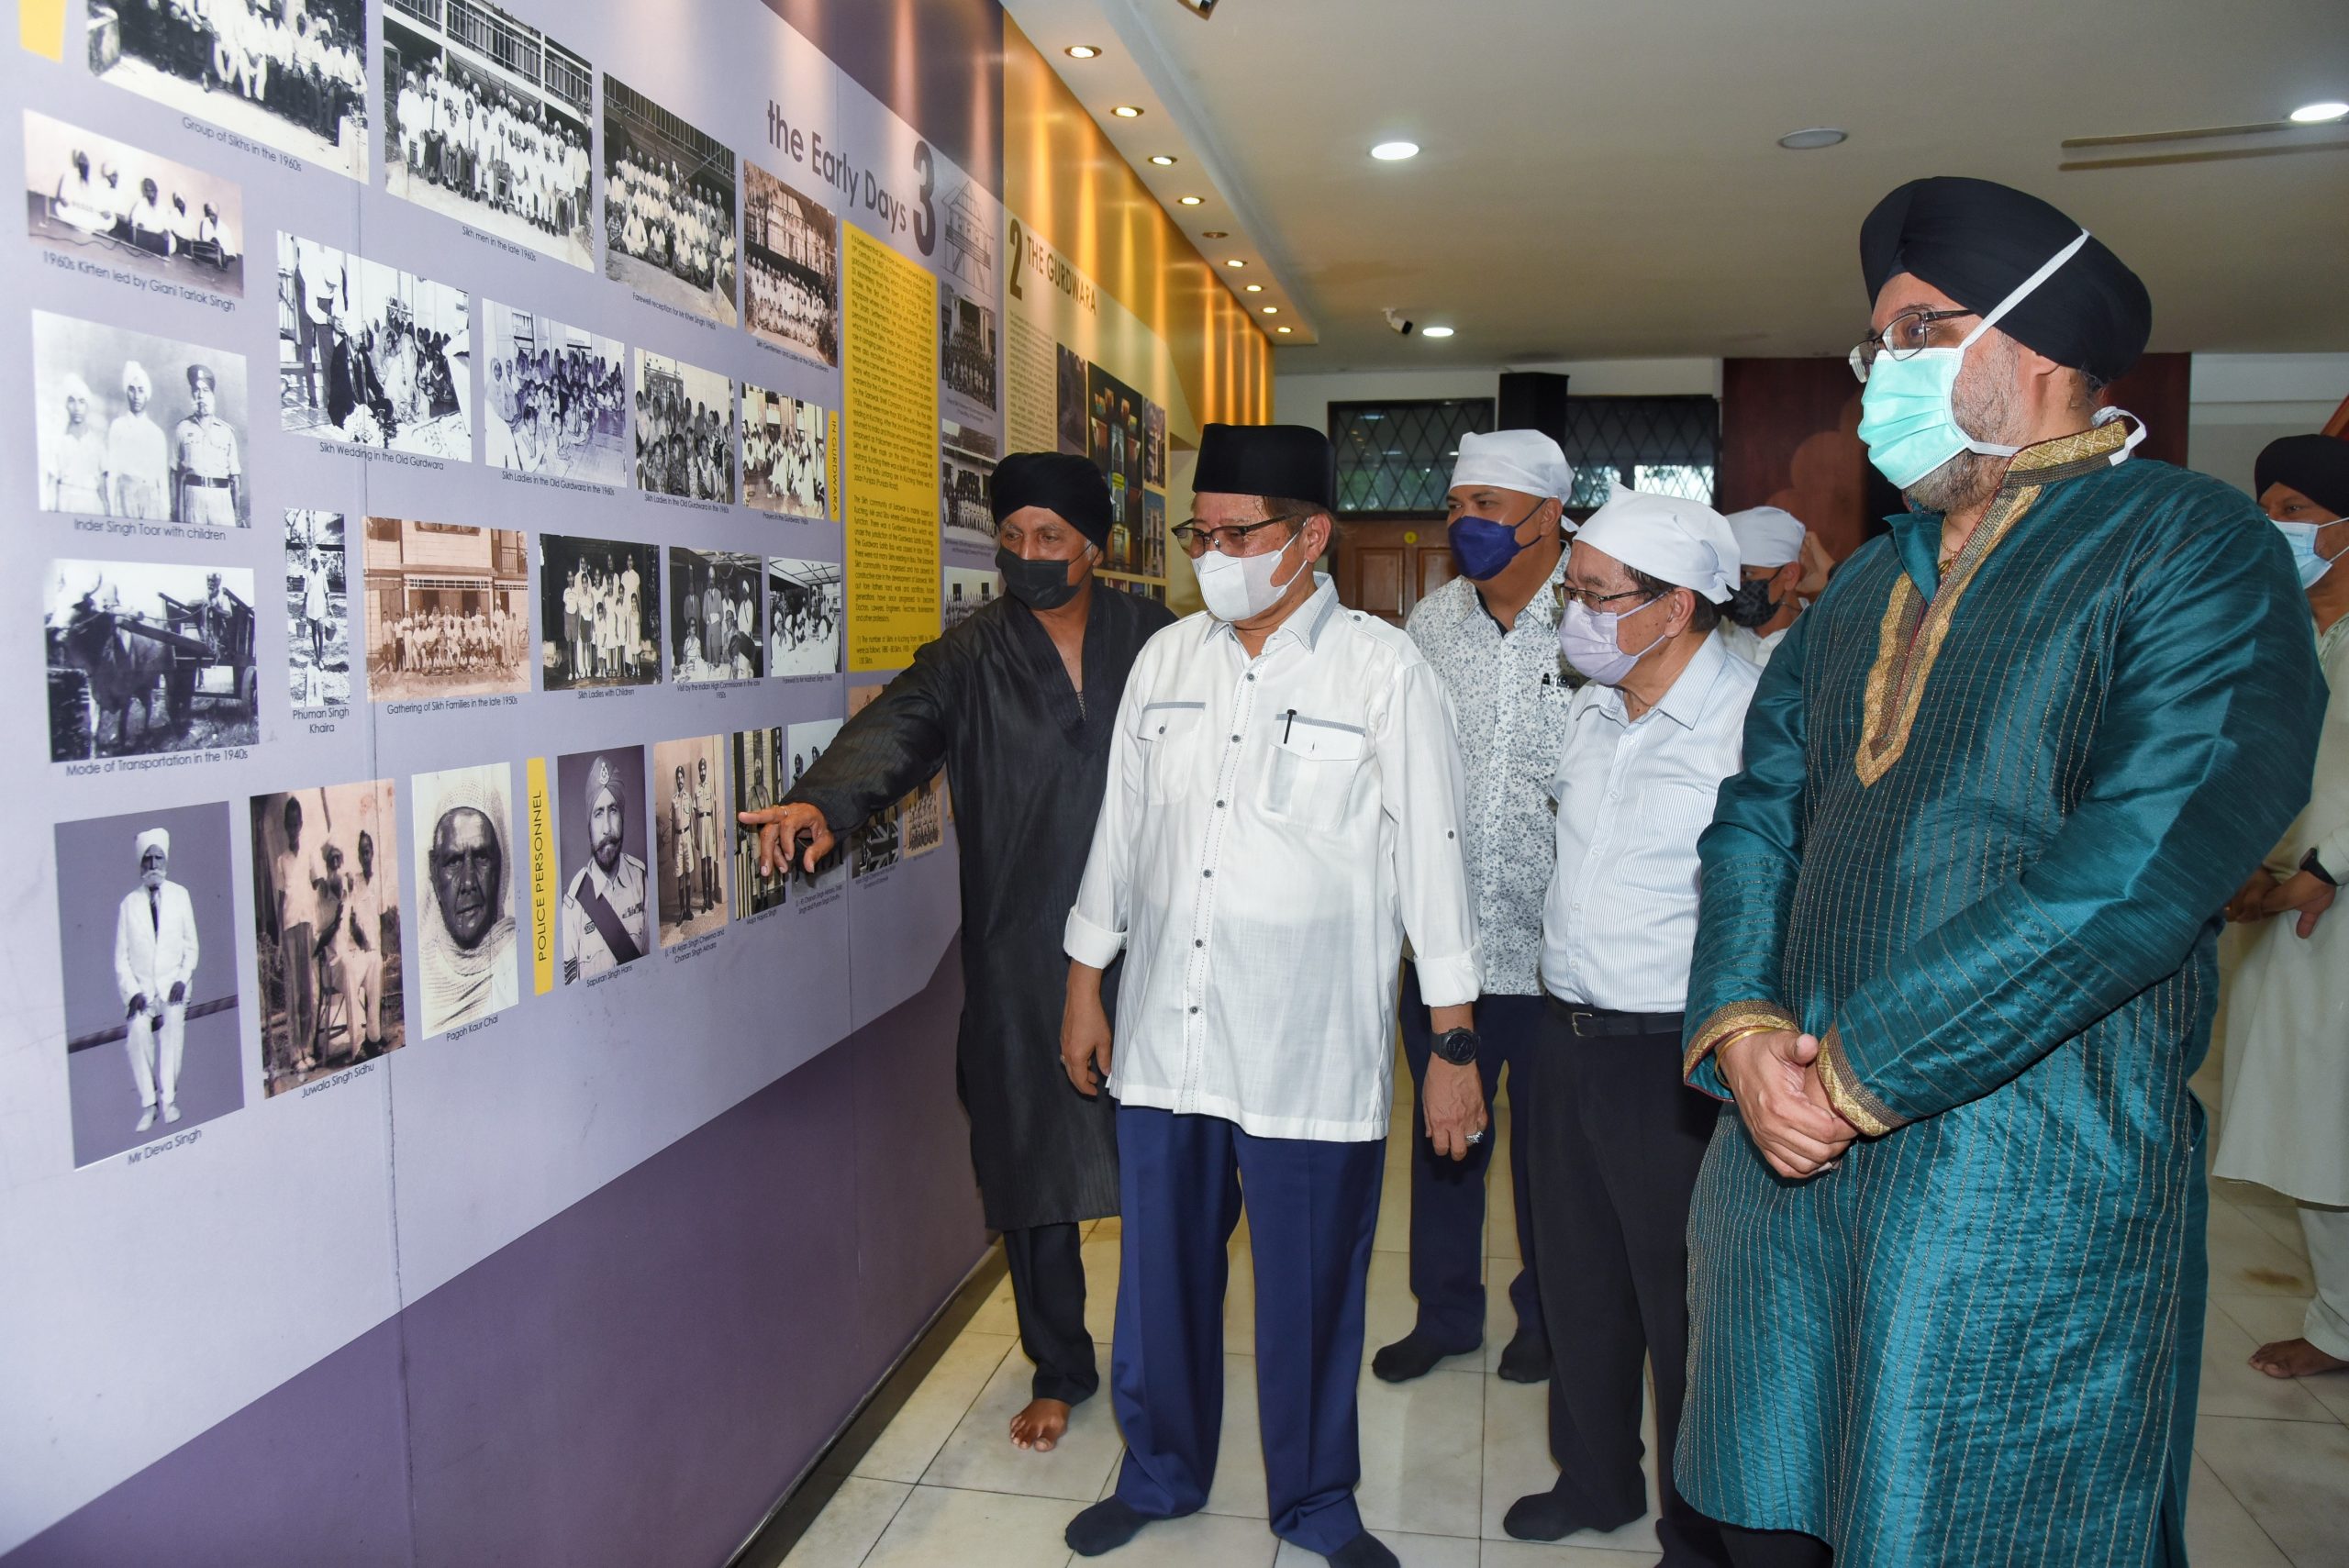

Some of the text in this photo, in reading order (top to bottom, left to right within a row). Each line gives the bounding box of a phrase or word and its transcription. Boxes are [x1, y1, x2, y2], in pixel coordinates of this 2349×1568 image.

[182, 117, 302, 172] Group of Sikhs in the 1960s
[767, 99, 936, 257] the Early Days 3
[462, 226, 536, 262] Sikh men in the late 1960s
[1009, 218, 1097, 317] 2 THE GURDWARA
[43, 250, 75, 271] 1960s
[112, 270, 130, 284] led
[133, 273, 148, 290] by
[150, 280, 177, 296] Giani
[179, 286, 207, 303] Tarlok
[210, 295, 235, 312] Singh
[632, 292, 651, 305] Farewell
[651, 300, 672, 314] reception
[831, 420, 837, 434] IN
[319, 442, 444, 471] Sikh Wedding in the Old Gurdwara
[502, 471, 514, 481] Sikh
[514, 473, 533, 484] Ladies
[533, 476, 539, 484] in
[539, 476, 549, 486] the
[550, 478, 560, 488] Old
[561, 480, 586, 492] Gurdwara
[586, 483, 592, 493] in
[592, 484, 601, 494] the
[653, 495, 668, 505] Ladies
[679, 499, 688, 507] Old
[688, 501, 708, 511] Gurdwara
[74, 518, 226, 540] Inder Singh Toar with children
[578, 688, 635, 699] Sikh Ladies with Children
[685, 684, 690, 693] by
[710, 682, 719, 691] High
[293, 706, 350, 719] Phuman Singh
[387, 695, 518, 715] Gathering of Sikh Families in the late 1950s
[309, 722, 335, 734] Khaira
[66, 748, 248, 777] Mode of Transportation in the 1940s
[532, 790, 547, 962] POLICE PERSONNEL
[717, 928, 725, 937] and
[607, 969, 621, 980] Singh
[468, 1021, 483, 1033] Kaur
[302, 1063, 374, 1098] Juwala Singh Sidhu
[128, 1129, 202, 1165] Mr Deva Singh
